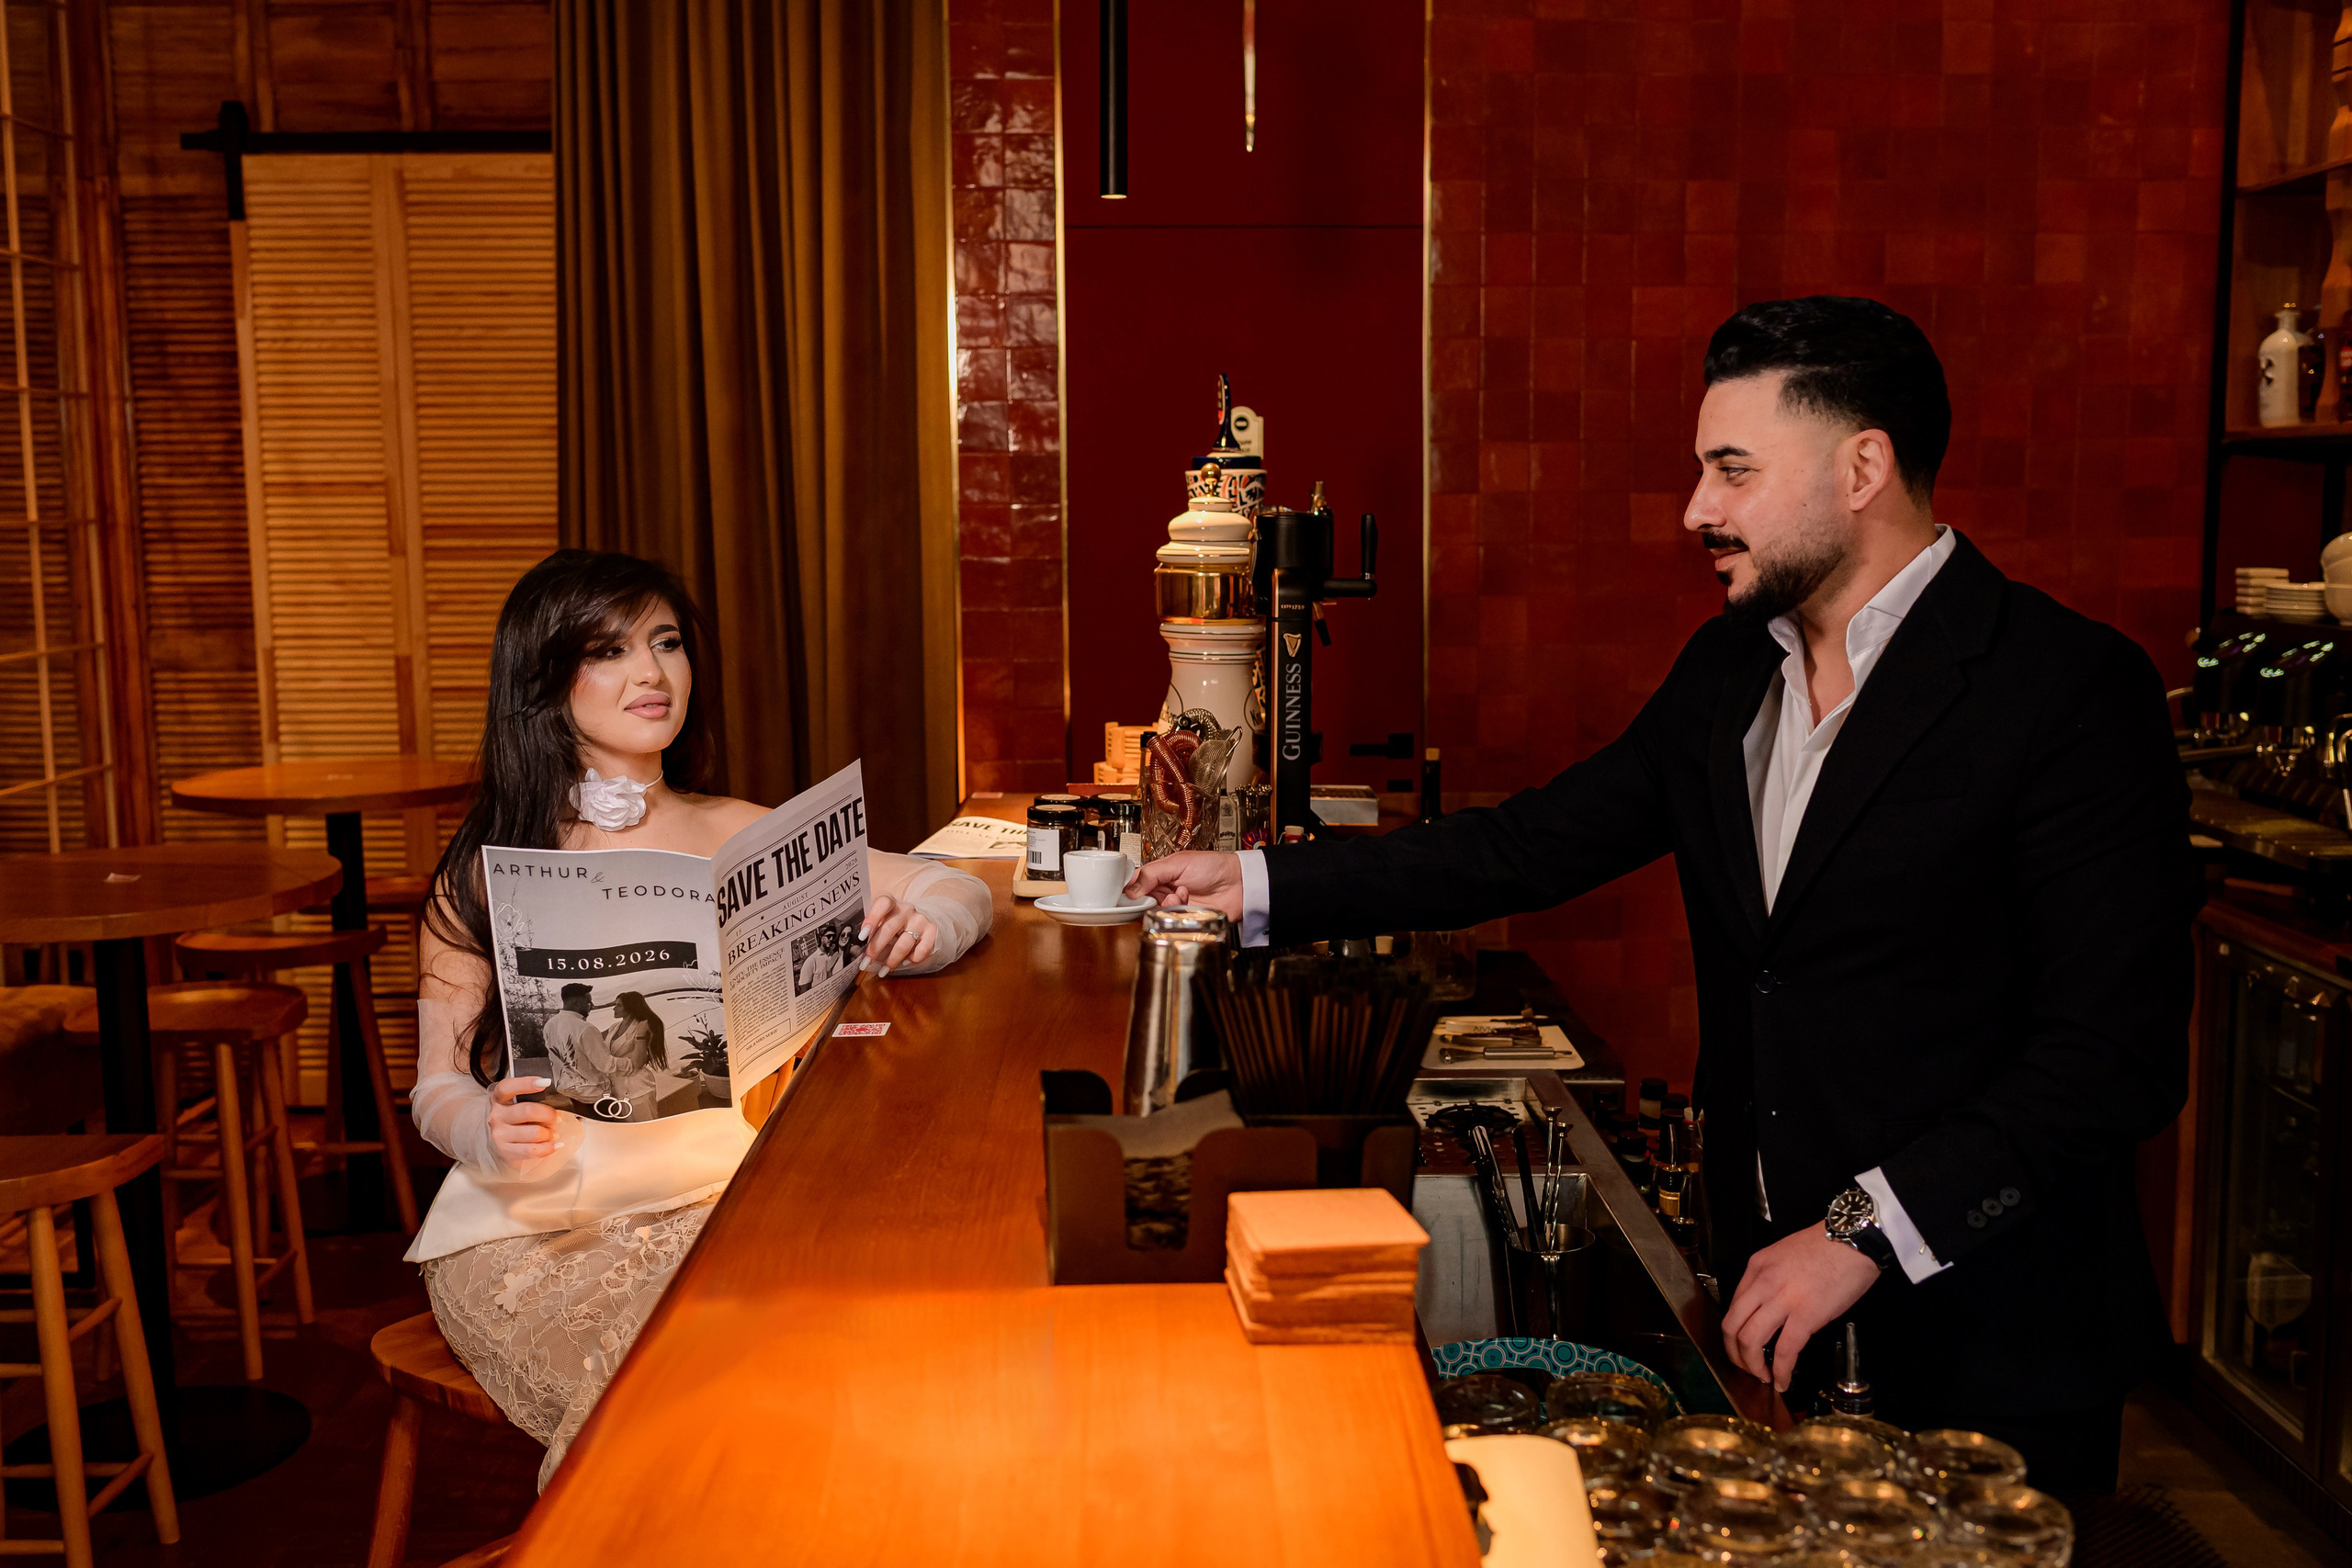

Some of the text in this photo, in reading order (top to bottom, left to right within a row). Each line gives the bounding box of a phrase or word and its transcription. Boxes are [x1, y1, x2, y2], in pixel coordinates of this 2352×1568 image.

[1283, 663, 1301, 761] GUINNESS
[952, 821, 990, 830] SAVE
[718, 796, 865, 929] SAVE THE DATE
[493, 863, 605, 884] ARTHUR &
[602, 885, 716, 903] TEODORA
[736, 857, 858, 937] 15 AUGUST 2026
[728, 871, 860, 966] BREAKING NEWS
[547, 949, 671, 970] 15.08.2026
[747, 962, 758, 972] THE
[760, 953, 783, 969] IMPACT
